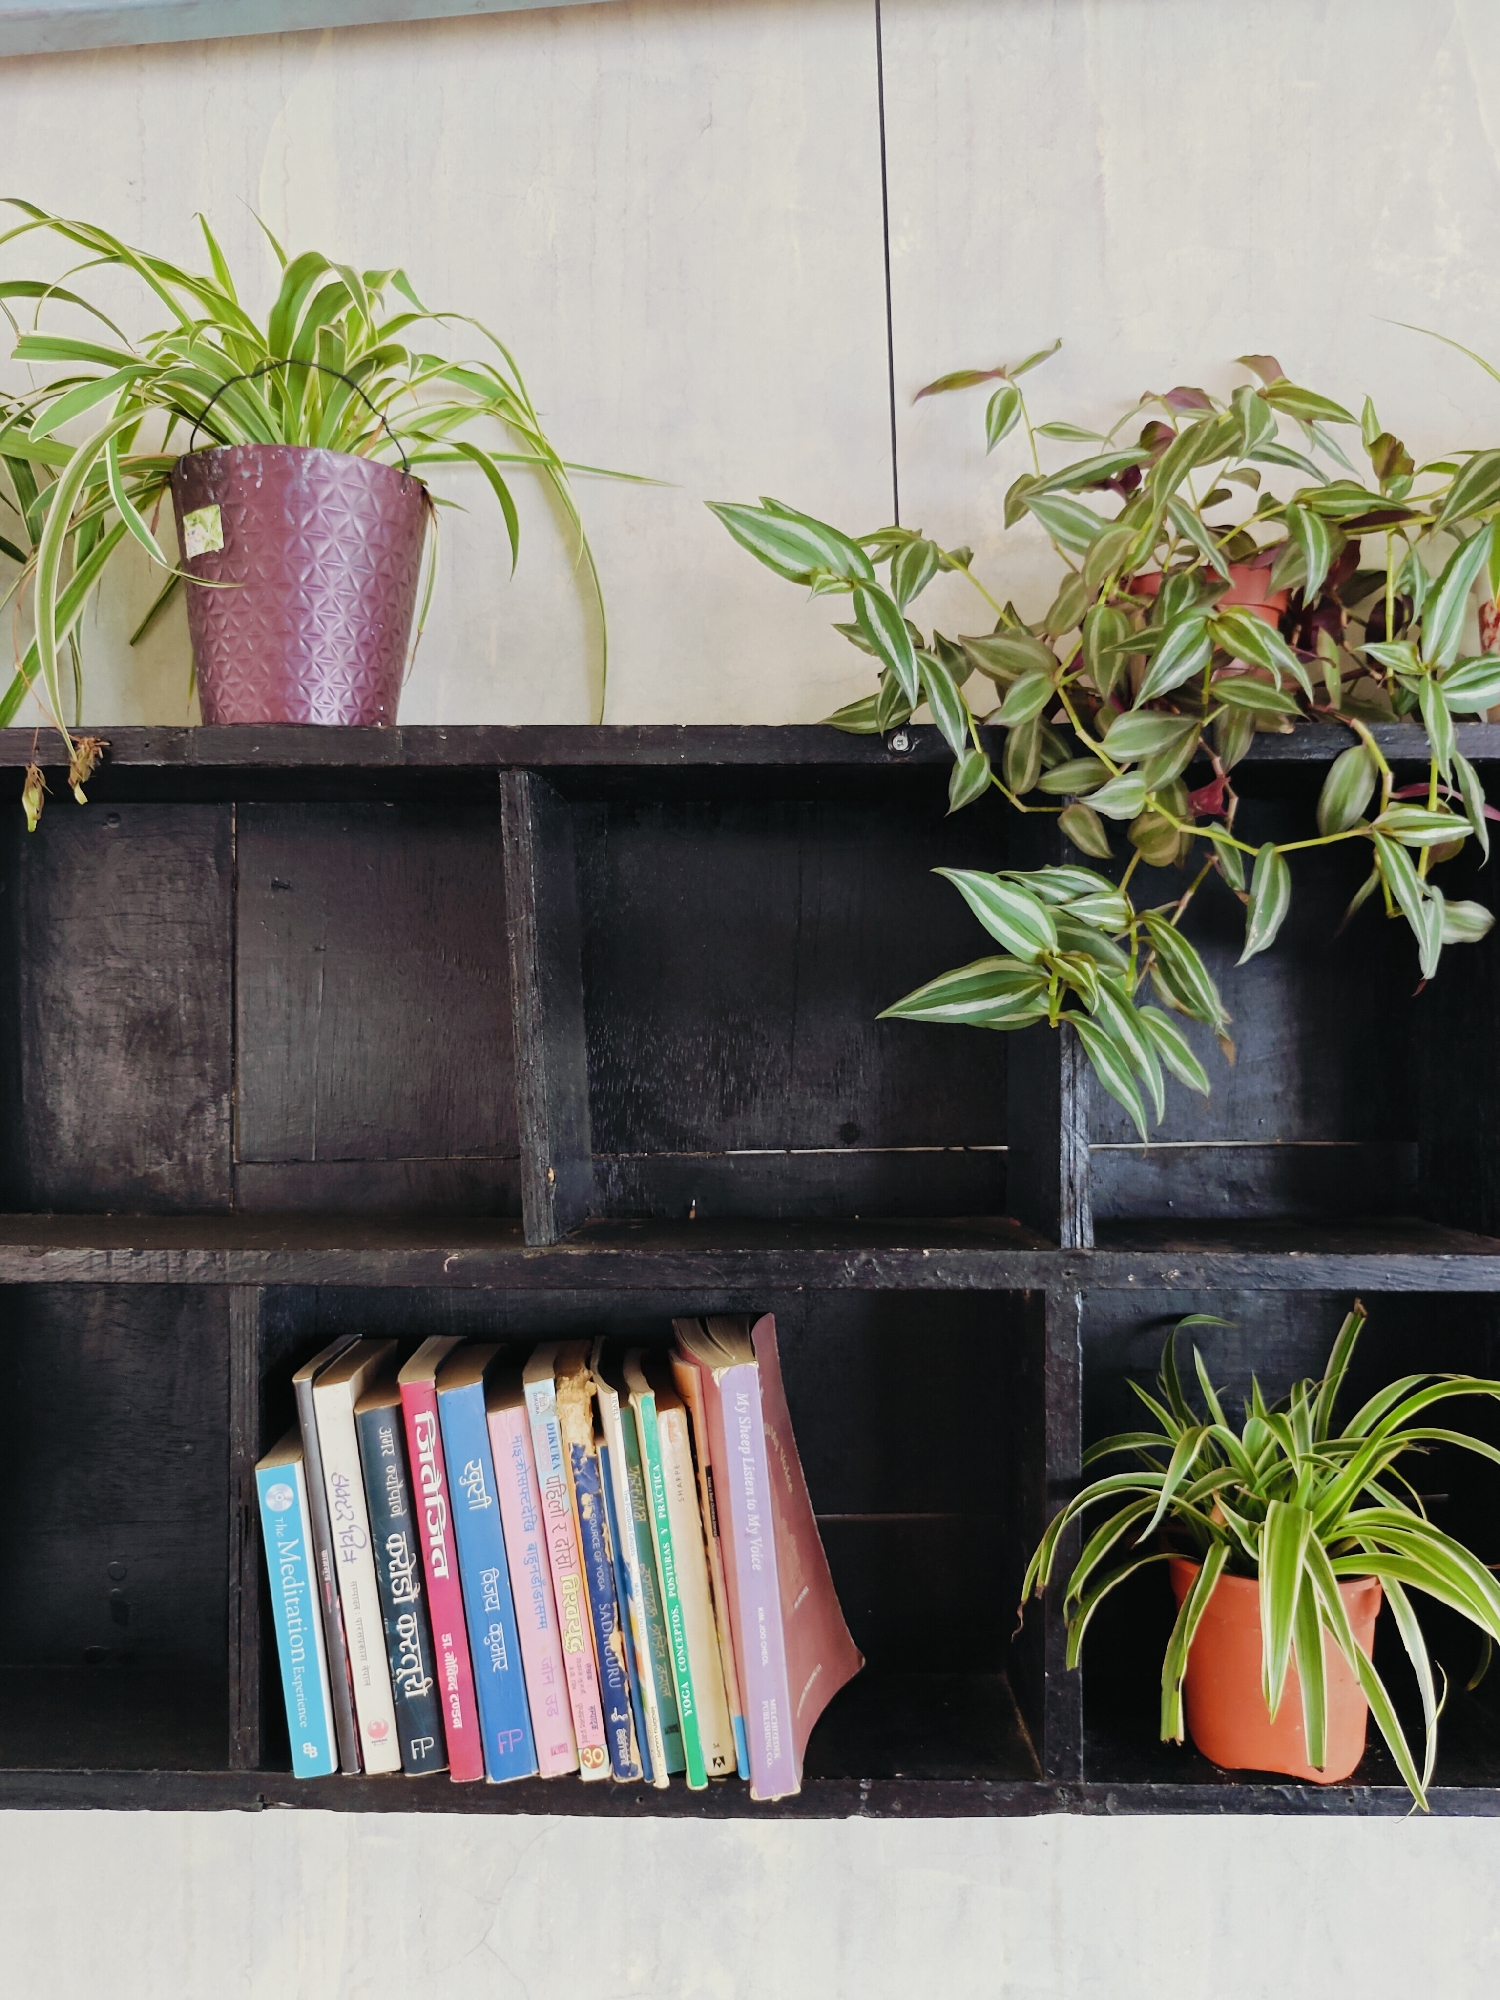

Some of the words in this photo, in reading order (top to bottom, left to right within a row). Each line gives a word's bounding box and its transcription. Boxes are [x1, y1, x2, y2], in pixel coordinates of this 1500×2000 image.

[733, 1391, 750, 1413] My
[378, 1426, 395, 1456] अमर
[546, 1422, 561, 1470] DIKURA
[737, 1415, 751, 1454] Sheep
[385, 1462, 407, 1518] न्यौपाने
[458, 1457, 492, 1510] खुसी
[652, 1464, 666, 1518] PRÁCTICA
[674, 1463, 685, 1503] SHARPE
[741, 1456, 755, 1495] Listen
[544, 1473, 570, 1518] पहिलो
[746, 1497, 757, 1510] to
[274, 1516, 288, 1537] The
[550, 1521, 567, 1533] र
[588, 1512, 600, 1547] SOURCE
[624, 1502, 633, 1531] Football
[659, 1526, 668, 1534] Y
[744, 1513, 761, 1534] My
[593, 1550, 602, 1562] OF
[627, 1532, 636, 1556] Ghosts
[749, 1536, 763, 1571] Voice
[595, 1565, 605, 1591] YOGA
[662, 1541, 676, 1597] POSTURAS
[276, 1538, 307, 1663] Meditation
[478, 1566, 500, 1612] विजय
[440, 1632, 453, 1649] डा.
[482, 1621, 508, 1672] कुमार
[670, 1604, 687, 1672] CONCEPTOS,
[758, 1623, 766, 1640] JOO
[395, 1611, 433, 1698] कस्तूरी
[442, 1650, 461, 1692] गोविन्द
[540, 1656, 558, 1685] जोन
[759, 1640, 768, 1667] CHEOL
[360, 1664, 371, 1686] नेपाल
[291, 1665, 307, 1728] Experience
[448, 1692, 462, 1729] टण्डन
[544, 1693, 559, 1717] उड
[680, 1680, 692, 1717] YOGA
[761, 1699, 771, 1751] PUBLISHING
[769, 1698, 780, 1759] MELCHIZEDEK
[765, 1751, 773, 1768] CO.
